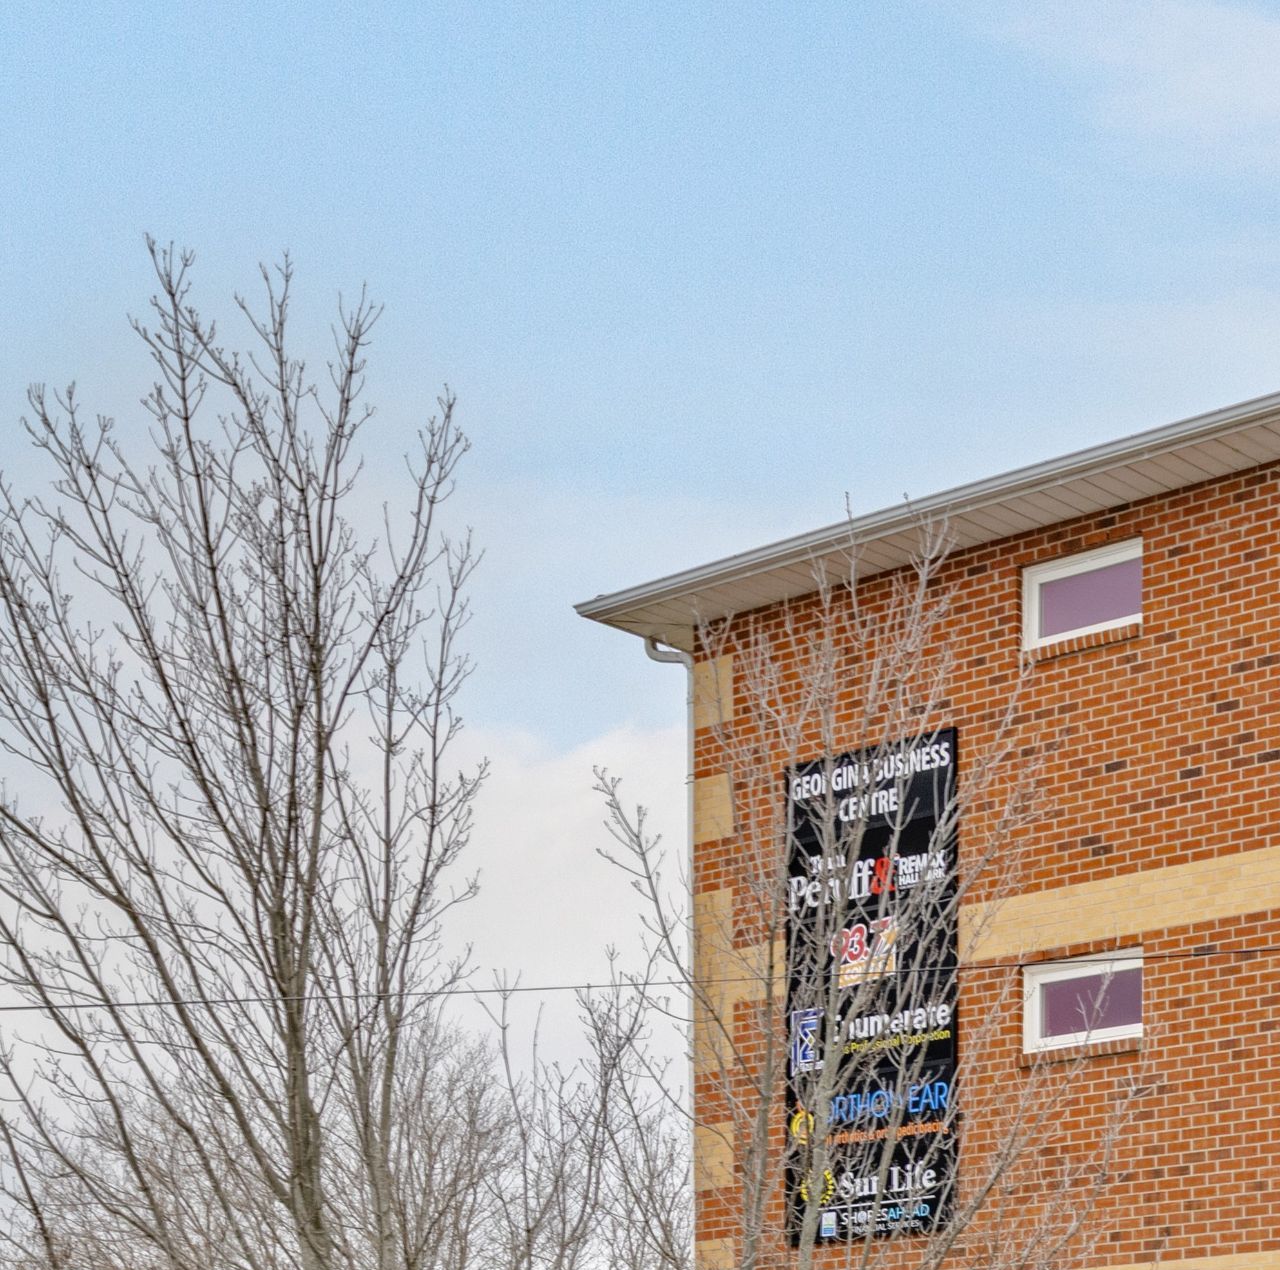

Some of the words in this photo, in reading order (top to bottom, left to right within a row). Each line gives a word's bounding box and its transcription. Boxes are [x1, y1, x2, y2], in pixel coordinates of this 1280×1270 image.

[899, 869, 946, 886] HALLARK
[833, 1002, 951, 1042] numerate
[890, 1160, 937, 1192] Life
[841, 1203, 930, 1226] SHOESAHAD
